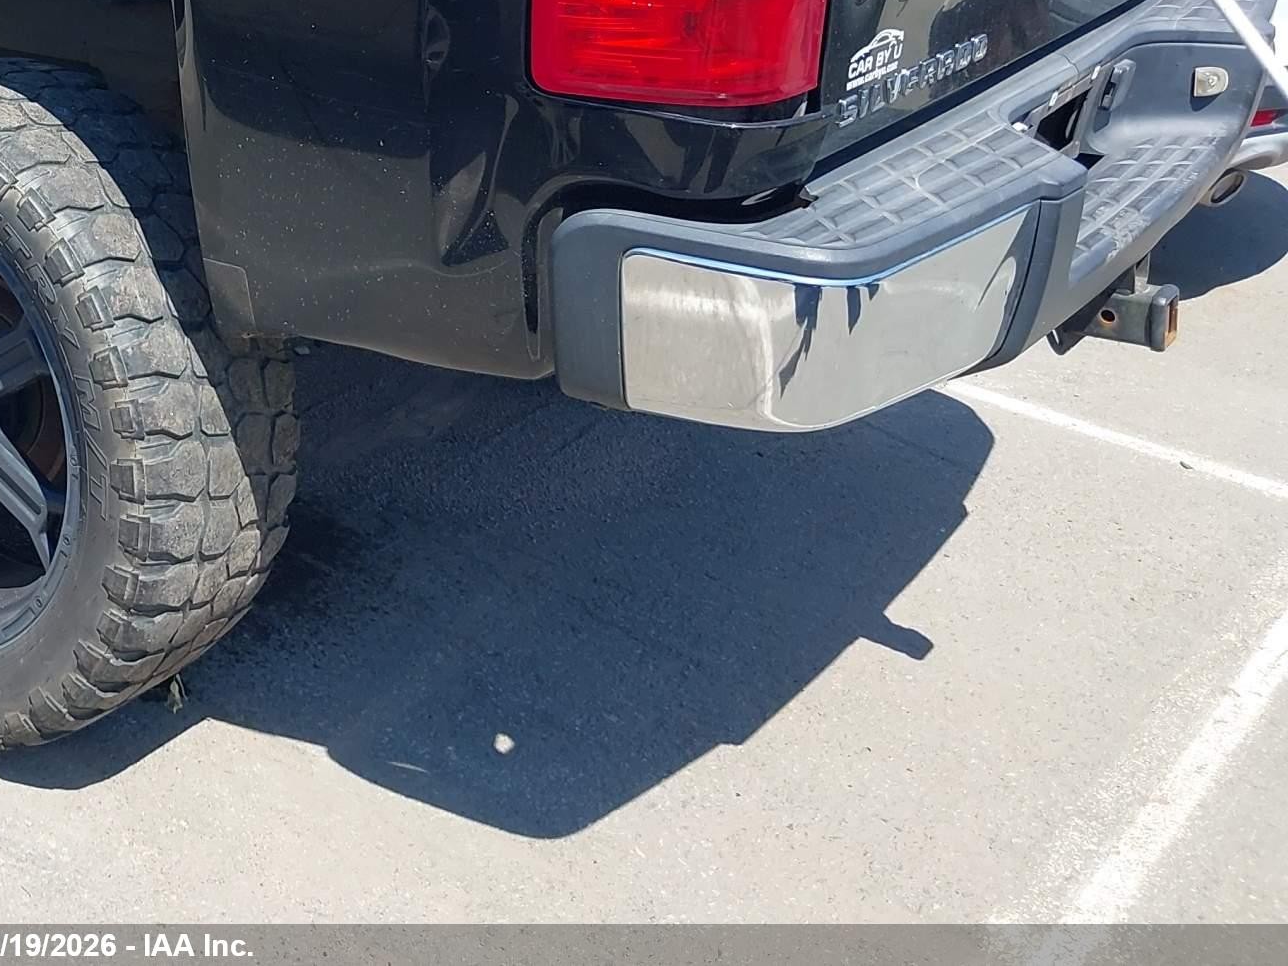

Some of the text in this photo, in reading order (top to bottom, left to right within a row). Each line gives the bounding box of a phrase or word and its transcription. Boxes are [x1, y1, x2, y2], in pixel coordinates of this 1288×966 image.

[836, 33, 988, 127] SILVERADO
[848, 42, 903, 79] CAR BY U
